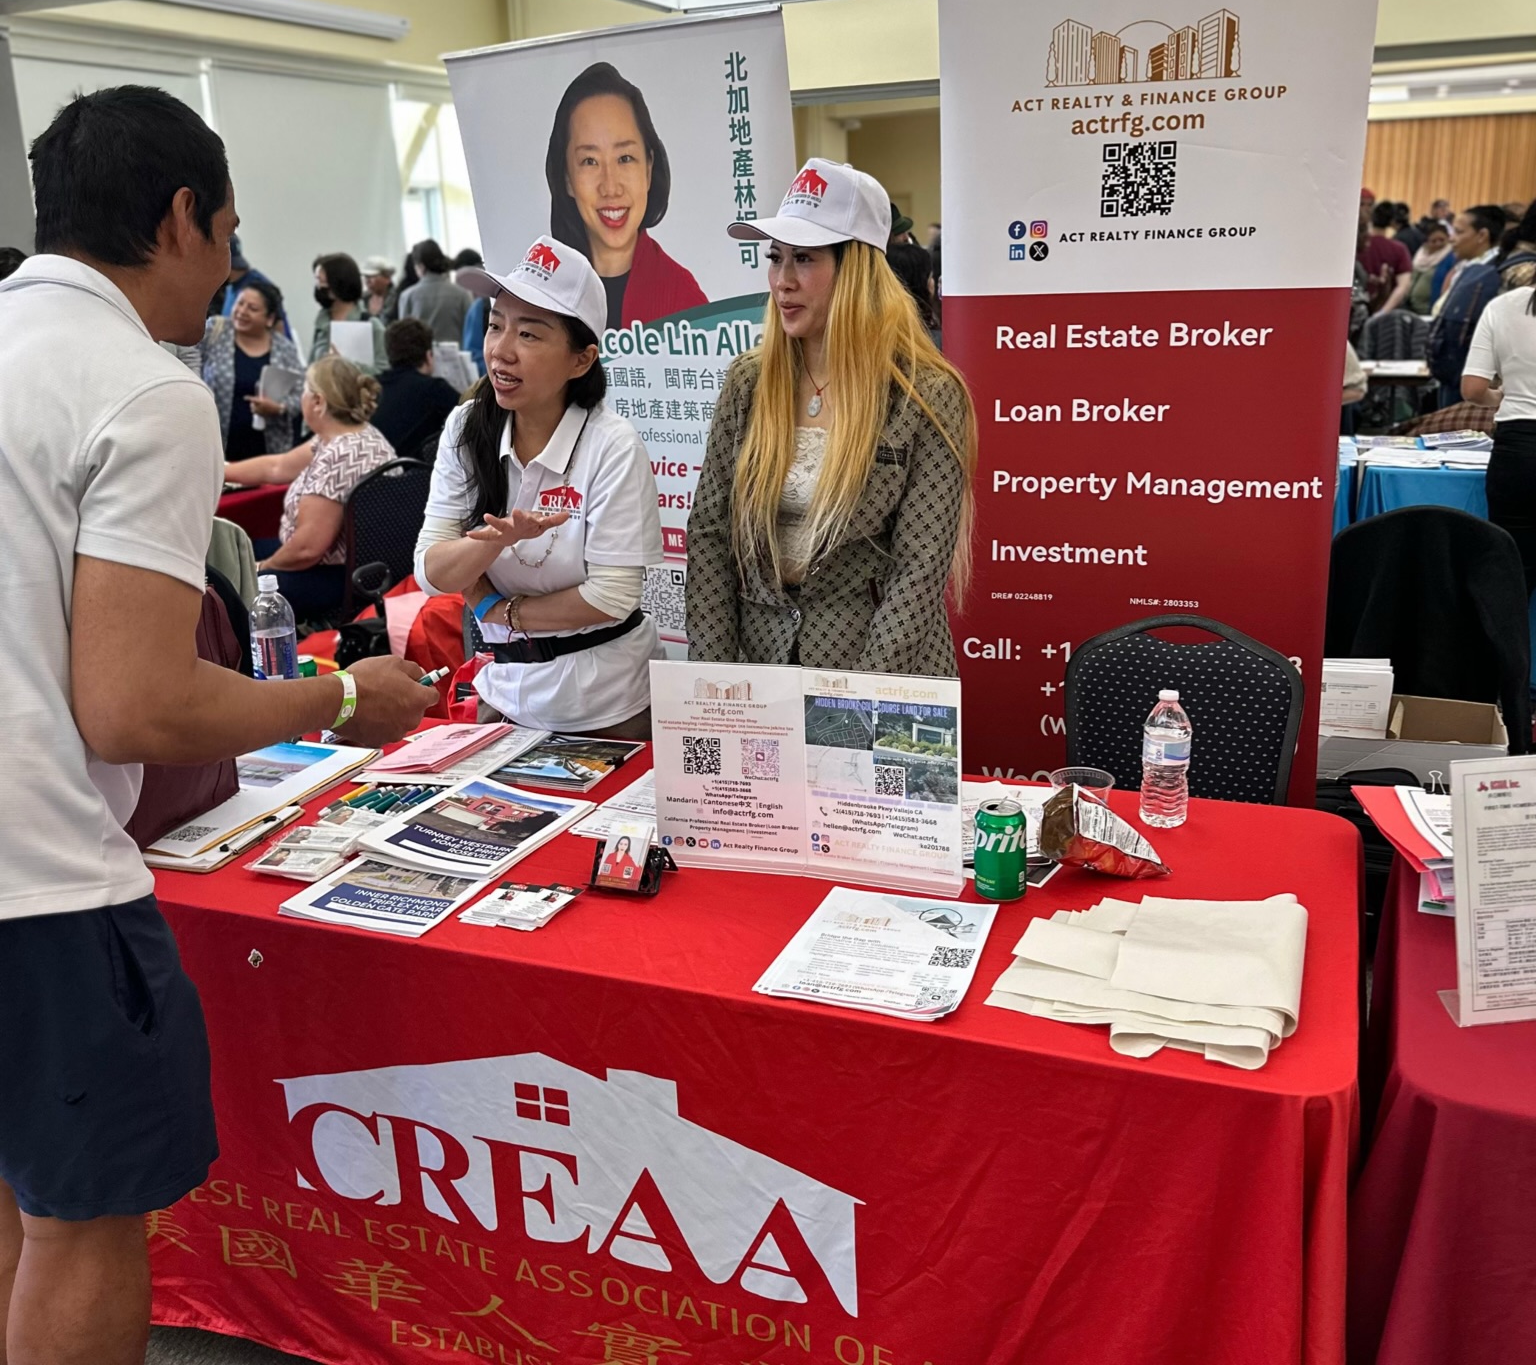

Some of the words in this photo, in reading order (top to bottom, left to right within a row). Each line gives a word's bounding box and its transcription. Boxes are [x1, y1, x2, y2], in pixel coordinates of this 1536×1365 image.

[1011, 98, 1045, 113] ACT
[1051, 95, 1115, 111] REALTY
[1122, 93, 1134, 107] &
[1140, 89, 1217, 106] FINANCE
[1225, 85, 1288, 102] GROUP
[1071, 111, 1206, 138] actrfg.com
[1059, 231, 1086, 244] ACT
[1090, 230, 1140, 242] REALTY
[1145, 227, 1204, 240] FINANCE
[1208, 225, 1257, 238] GROUP
[604, 322, 660, 356] cole
[667, 326, 708, 356] Lin
[996, 325, 1057, 350] Real
[1065, 324, 1160, 349] Estate
[1169, 321, 1273, 348] Broker
[994, 399, 1062, 422] Loan
[1071, 399, 1170, 422] Broker
[638, 428, 703, 445] rofessional
[651, 455, 688, 478] vice
[992, 470, 1117, 501] Property
[1126, 471, 1323, 504] Management
[991, 540, 1148, 567] Investment
[991, 591, 1013, 601] DRE#
[1014, 592, 1053, 602] 02248819
[1129, 596, 1162, 607] NMLS#:
[1163, 598, 1199, 609] 2803353
[963, 637, 1022, 662] Call:
[414, 825, 460, 844] TURNKEY
[458, 839, 513, 853] WESTPARK
[431, 837, 463, 851] HOME
[446, 848, 502, 862] ROSEVILLE
[330, 896, 377, 912] GOLDEN
[376, 905, 405, 915] GATE
[405, 910, 441, 920] PARK
[355, 889, 390, 901] INNER
[390, 894, 450, 909] RICHMOND
[369, 898, 412, 912] TRIPLEX
[413, 904, 445, 914] NEAR
[288, 1102, 845, 1314] CREAA
[262, 1196, 351, 1240] REAL
[364, 1218, 498, 1276] ESTATE
[514, 1258, 812, 1354] ASSOCIATION
